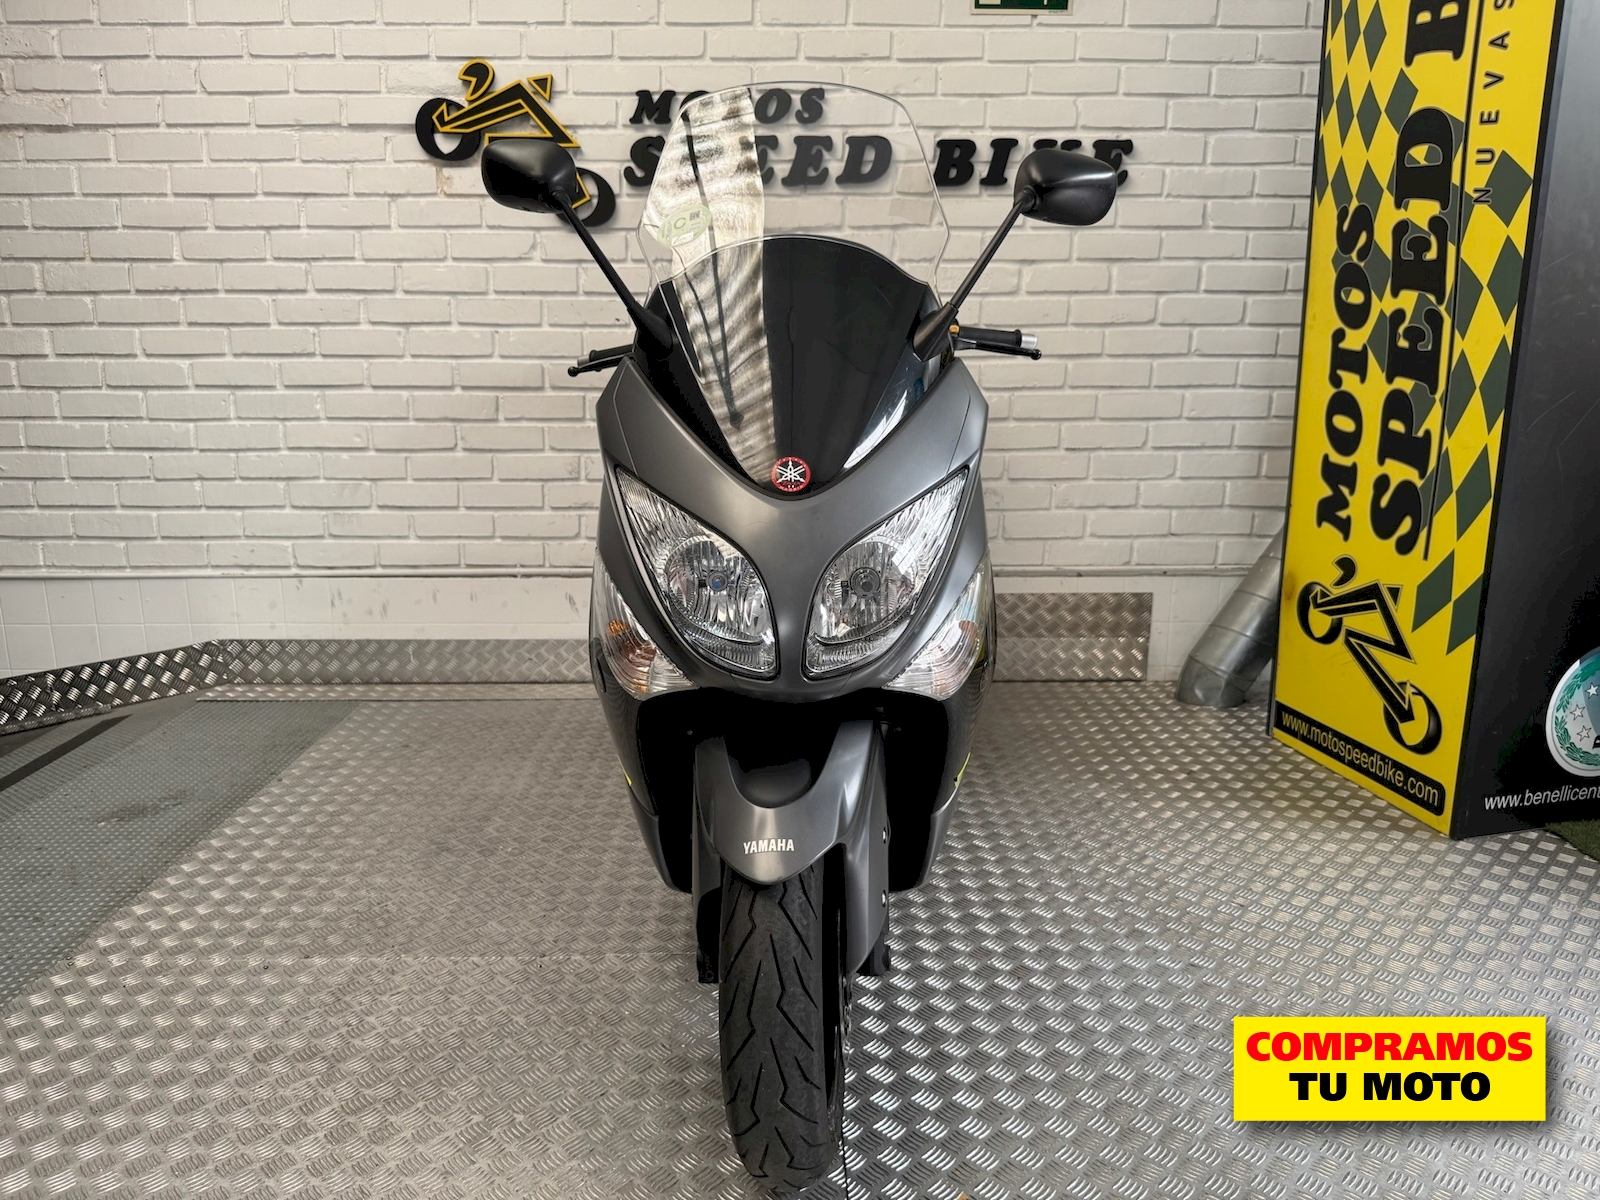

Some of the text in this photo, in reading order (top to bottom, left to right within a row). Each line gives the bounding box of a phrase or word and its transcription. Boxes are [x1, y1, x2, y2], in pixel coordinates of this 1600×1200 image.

[629, 88, 825, 124] MOS
[624, 135, 1134, 187] SED BIE
[1370, 107, 1453, 556] SPEED
[1316, 203, 1374, 541] MOTOS
[1281, 710, 1439, 807] www.motospeedbike.com
[743, 838, 795, 855] YAMAHA
